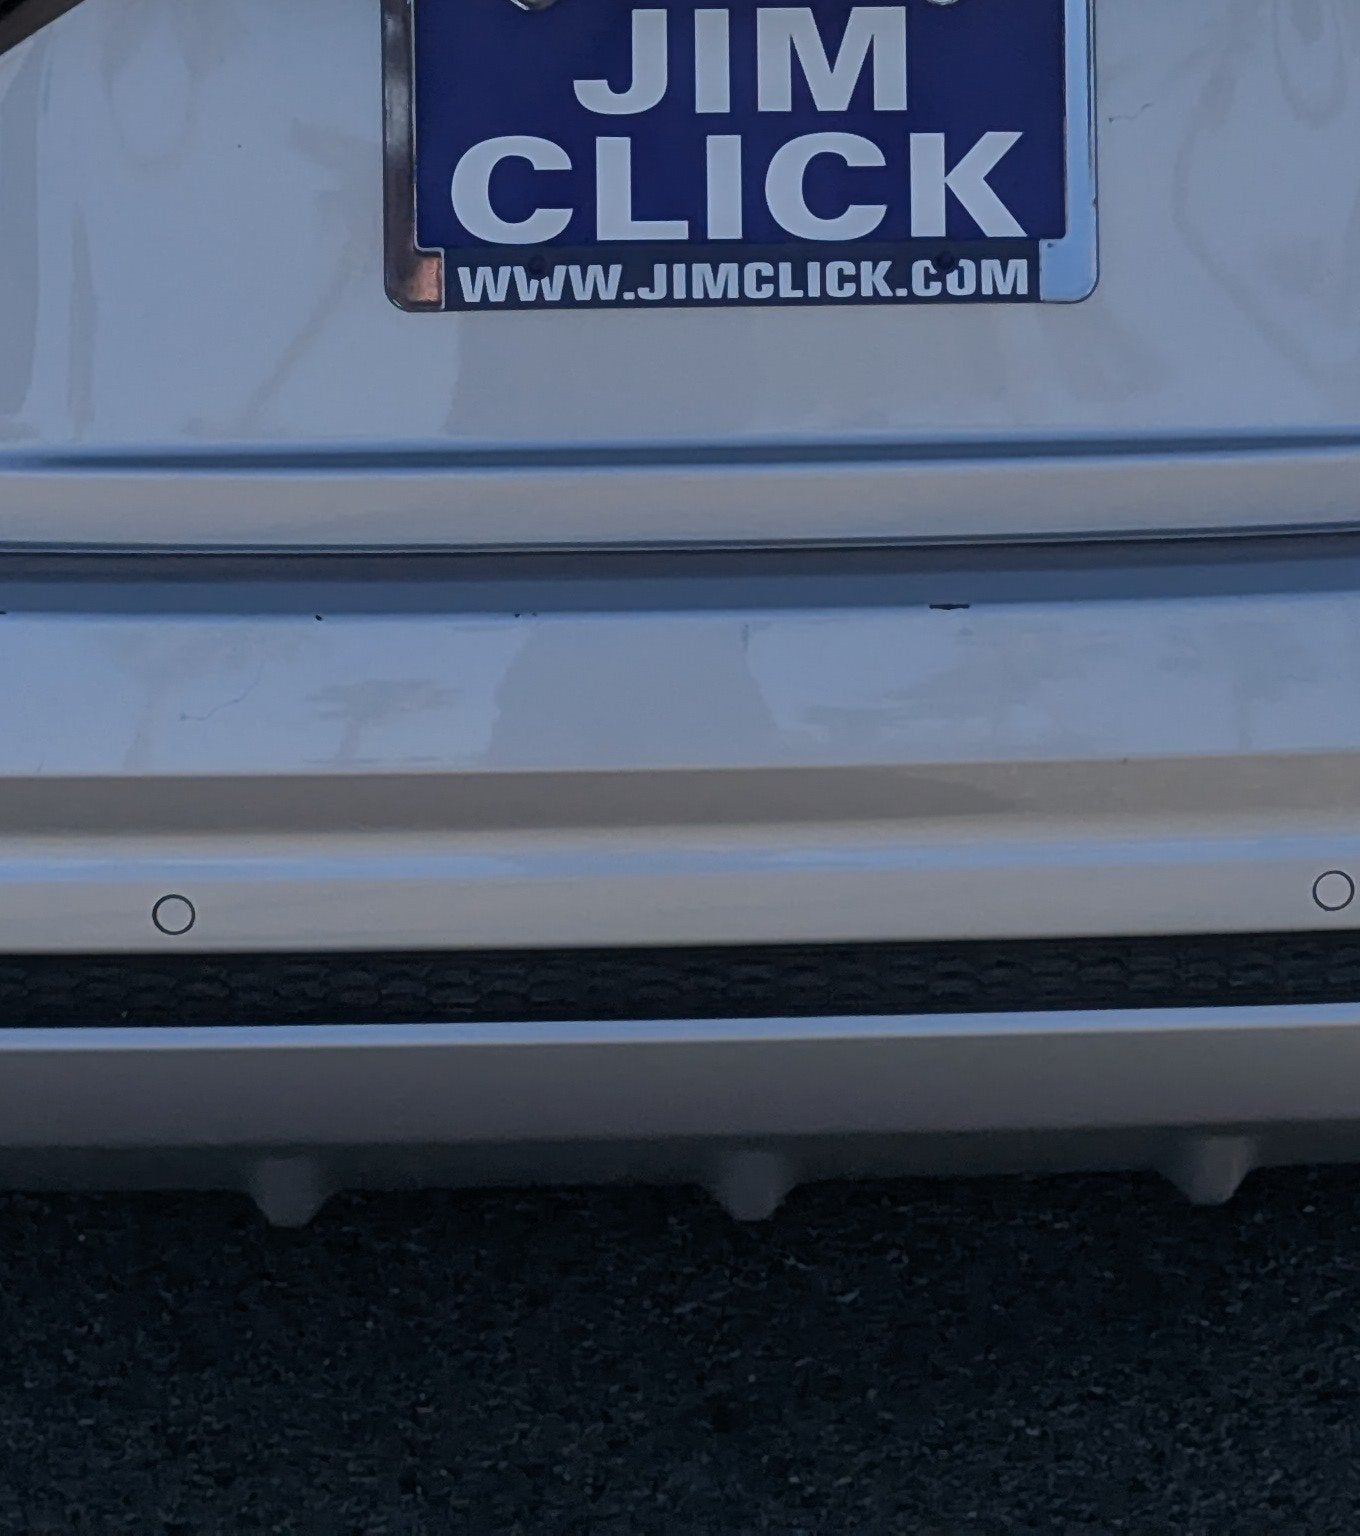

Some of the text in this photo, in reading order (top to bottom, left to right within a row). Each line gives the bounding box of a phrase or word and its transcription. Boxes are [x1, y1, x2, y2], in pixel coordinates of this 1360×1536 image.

[573, 5, 908, 115] JIM
[450, 131, 1028, 245] CLICK
[457, 258, 1029, 303] WWW.JIMCLICK.COM
